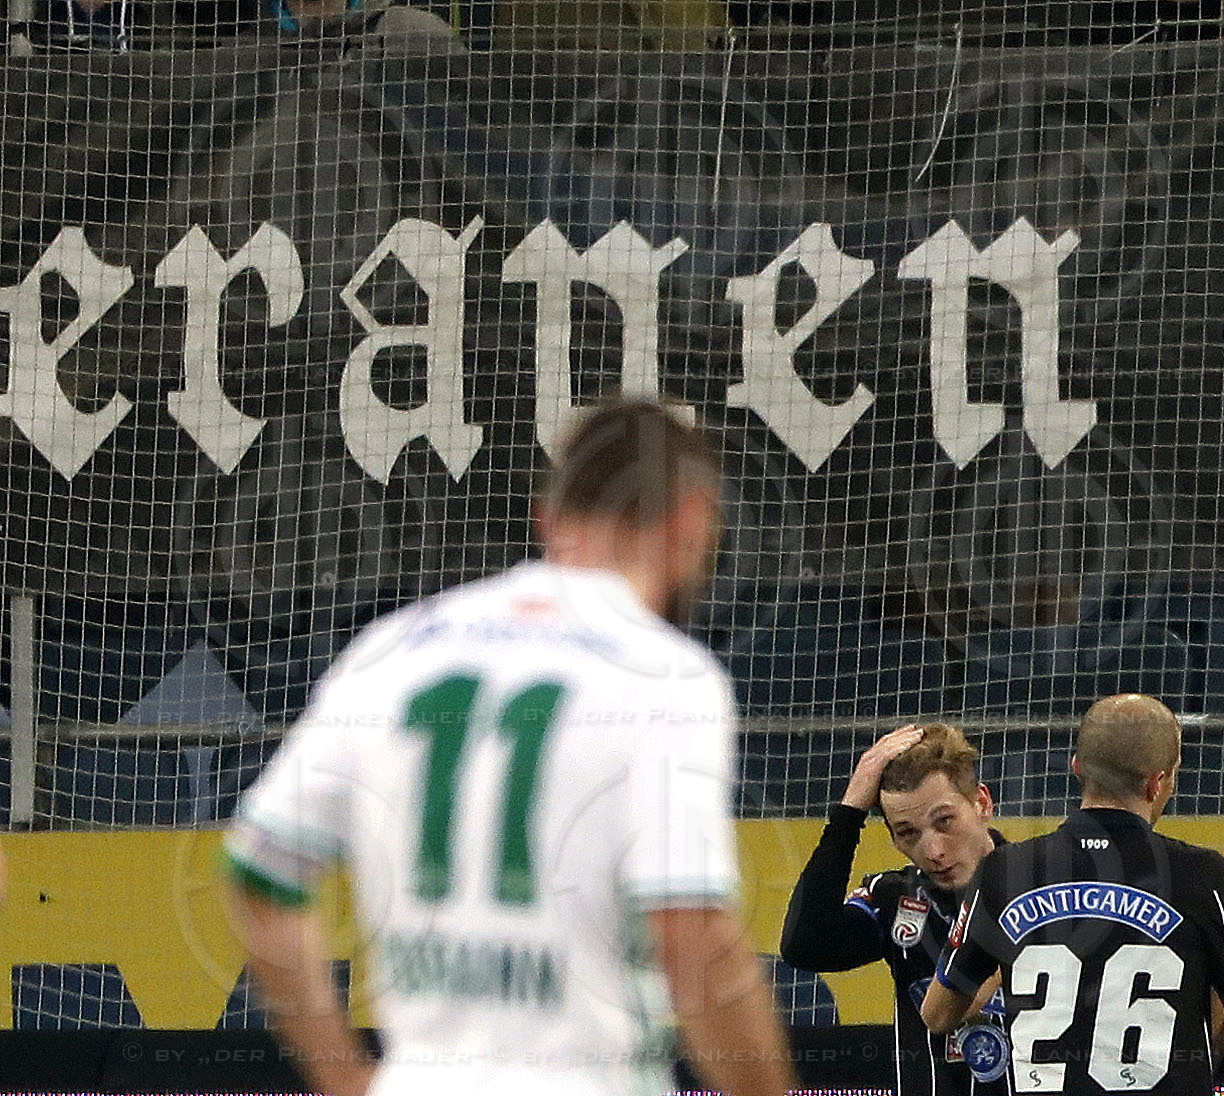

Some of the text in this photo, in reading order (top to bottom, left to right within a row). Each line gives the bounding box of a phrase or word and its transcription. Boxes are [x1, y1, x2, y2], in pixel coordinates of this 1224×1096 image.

[402, 666, 568, 905] 11
[1080, 838, 1109, 850] 1909
[1005, 887, 1171, 934] PUNTIGAMER
[1010, 944, 1185, 1094] 26
